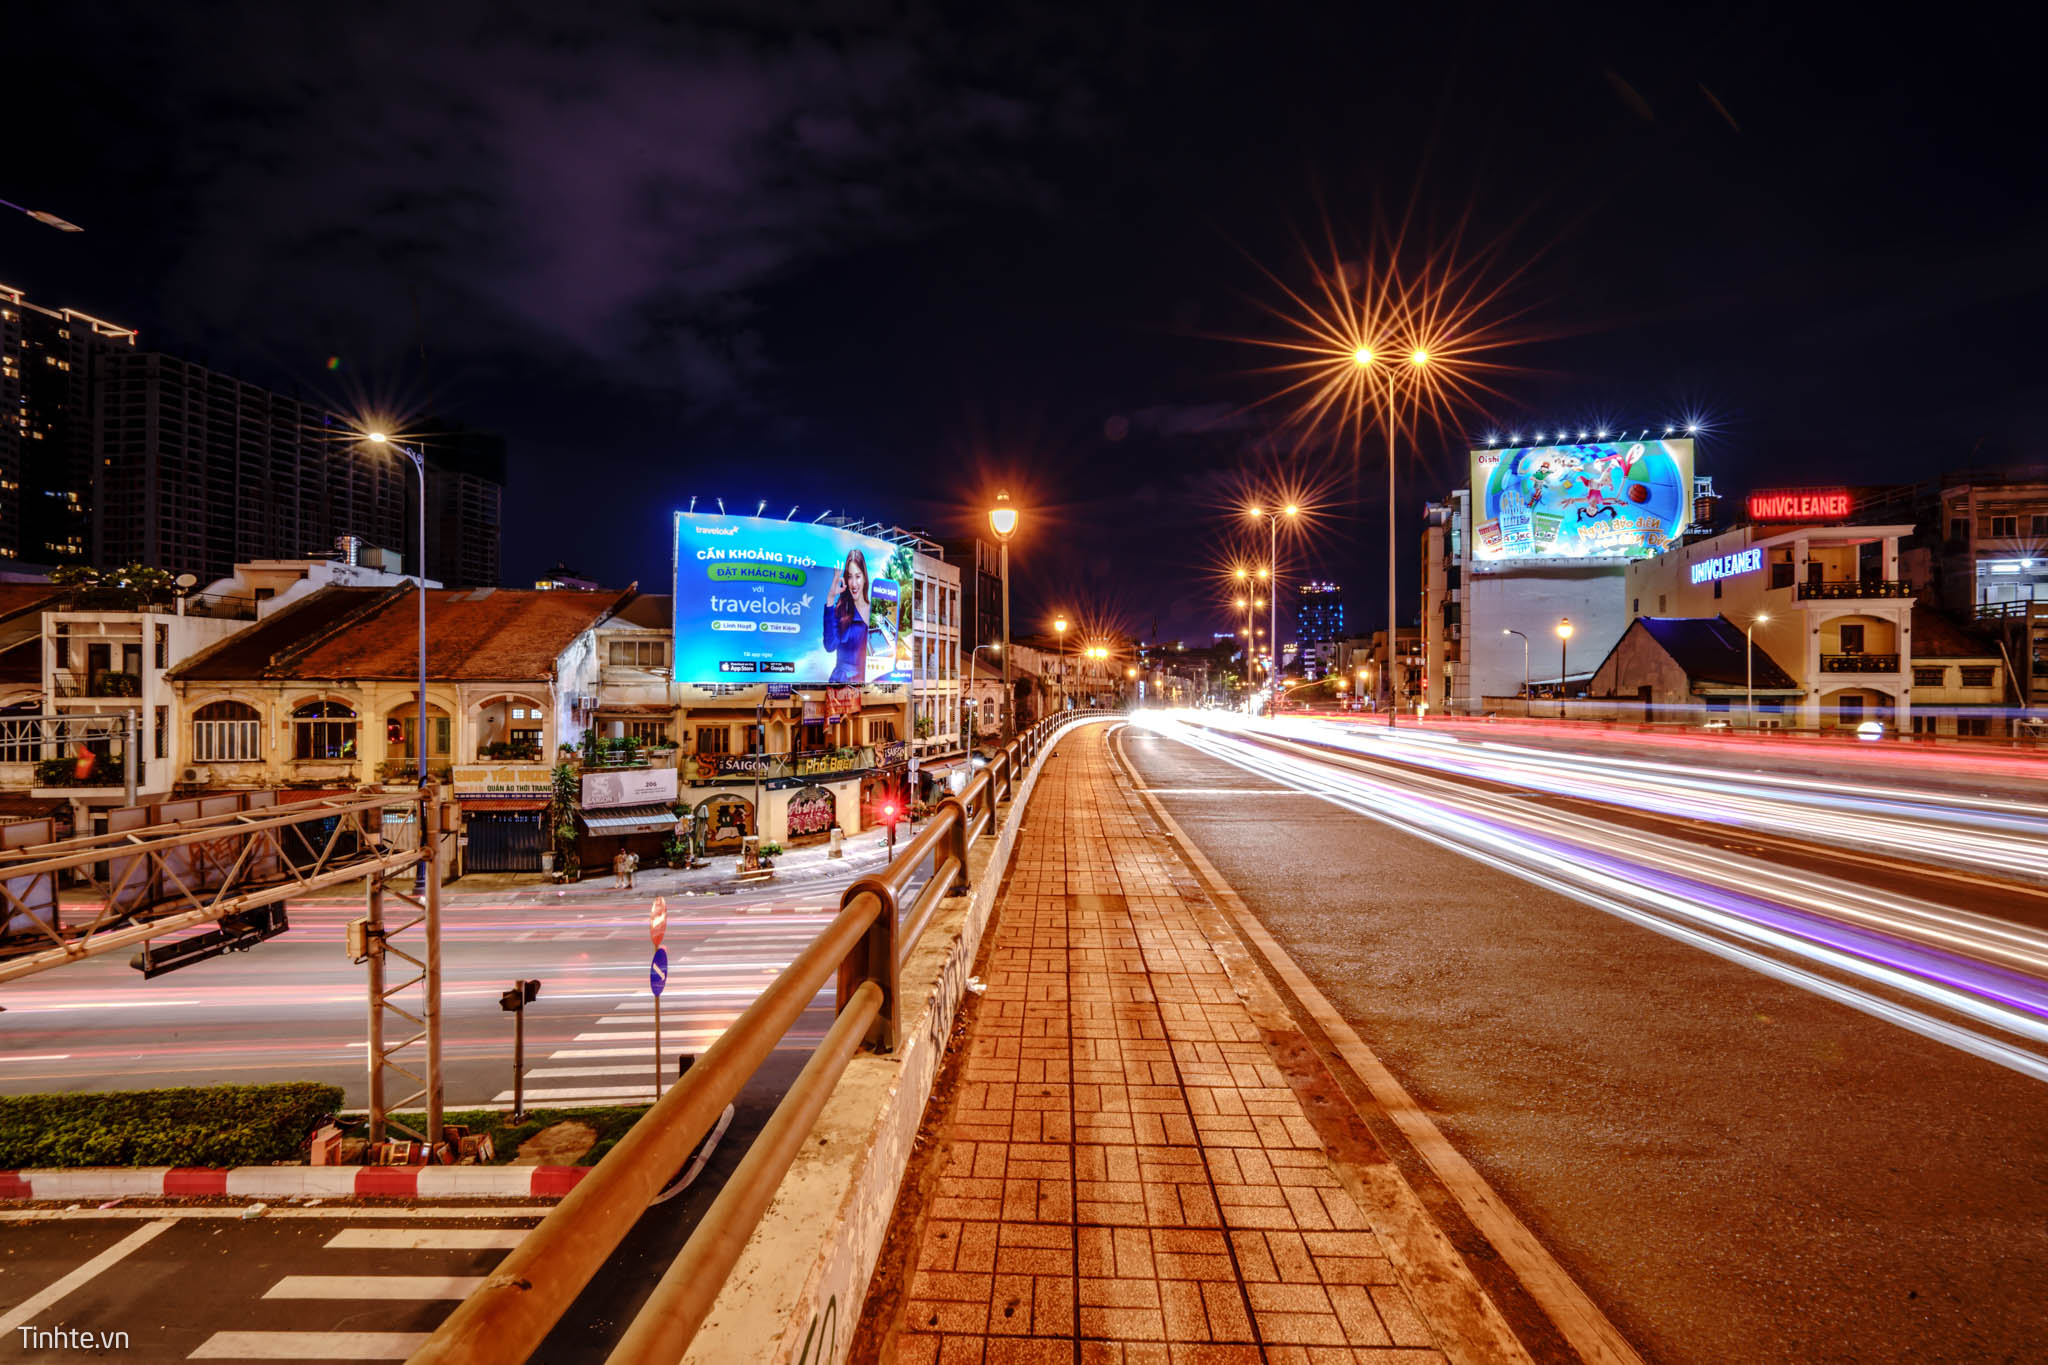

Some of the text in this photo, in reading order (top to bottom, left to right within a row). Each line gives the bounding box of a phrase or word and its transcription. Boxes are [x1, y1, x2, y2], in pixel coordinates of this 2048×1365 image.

[1478, 455, 1500, 464] Oishi
[1753, 495, 1848, 517] UNIVCLEANER
[695, 525, 735, 536] traveloka
[729, 548, 783, 562] KHOẢNG
[786, 554, 817, 568] THỞ?
[1691, 547, 1762, 585] UNIVCLEANER
[716, 567, 800, 583] ĐẶT KHÁCH SẠN
[752, 585, 765, 593] với
[710, 594, 801, 616] traveloka
[725, 759, 770, 771] SAIGON
[532, 783, 552, 792] TRANG
